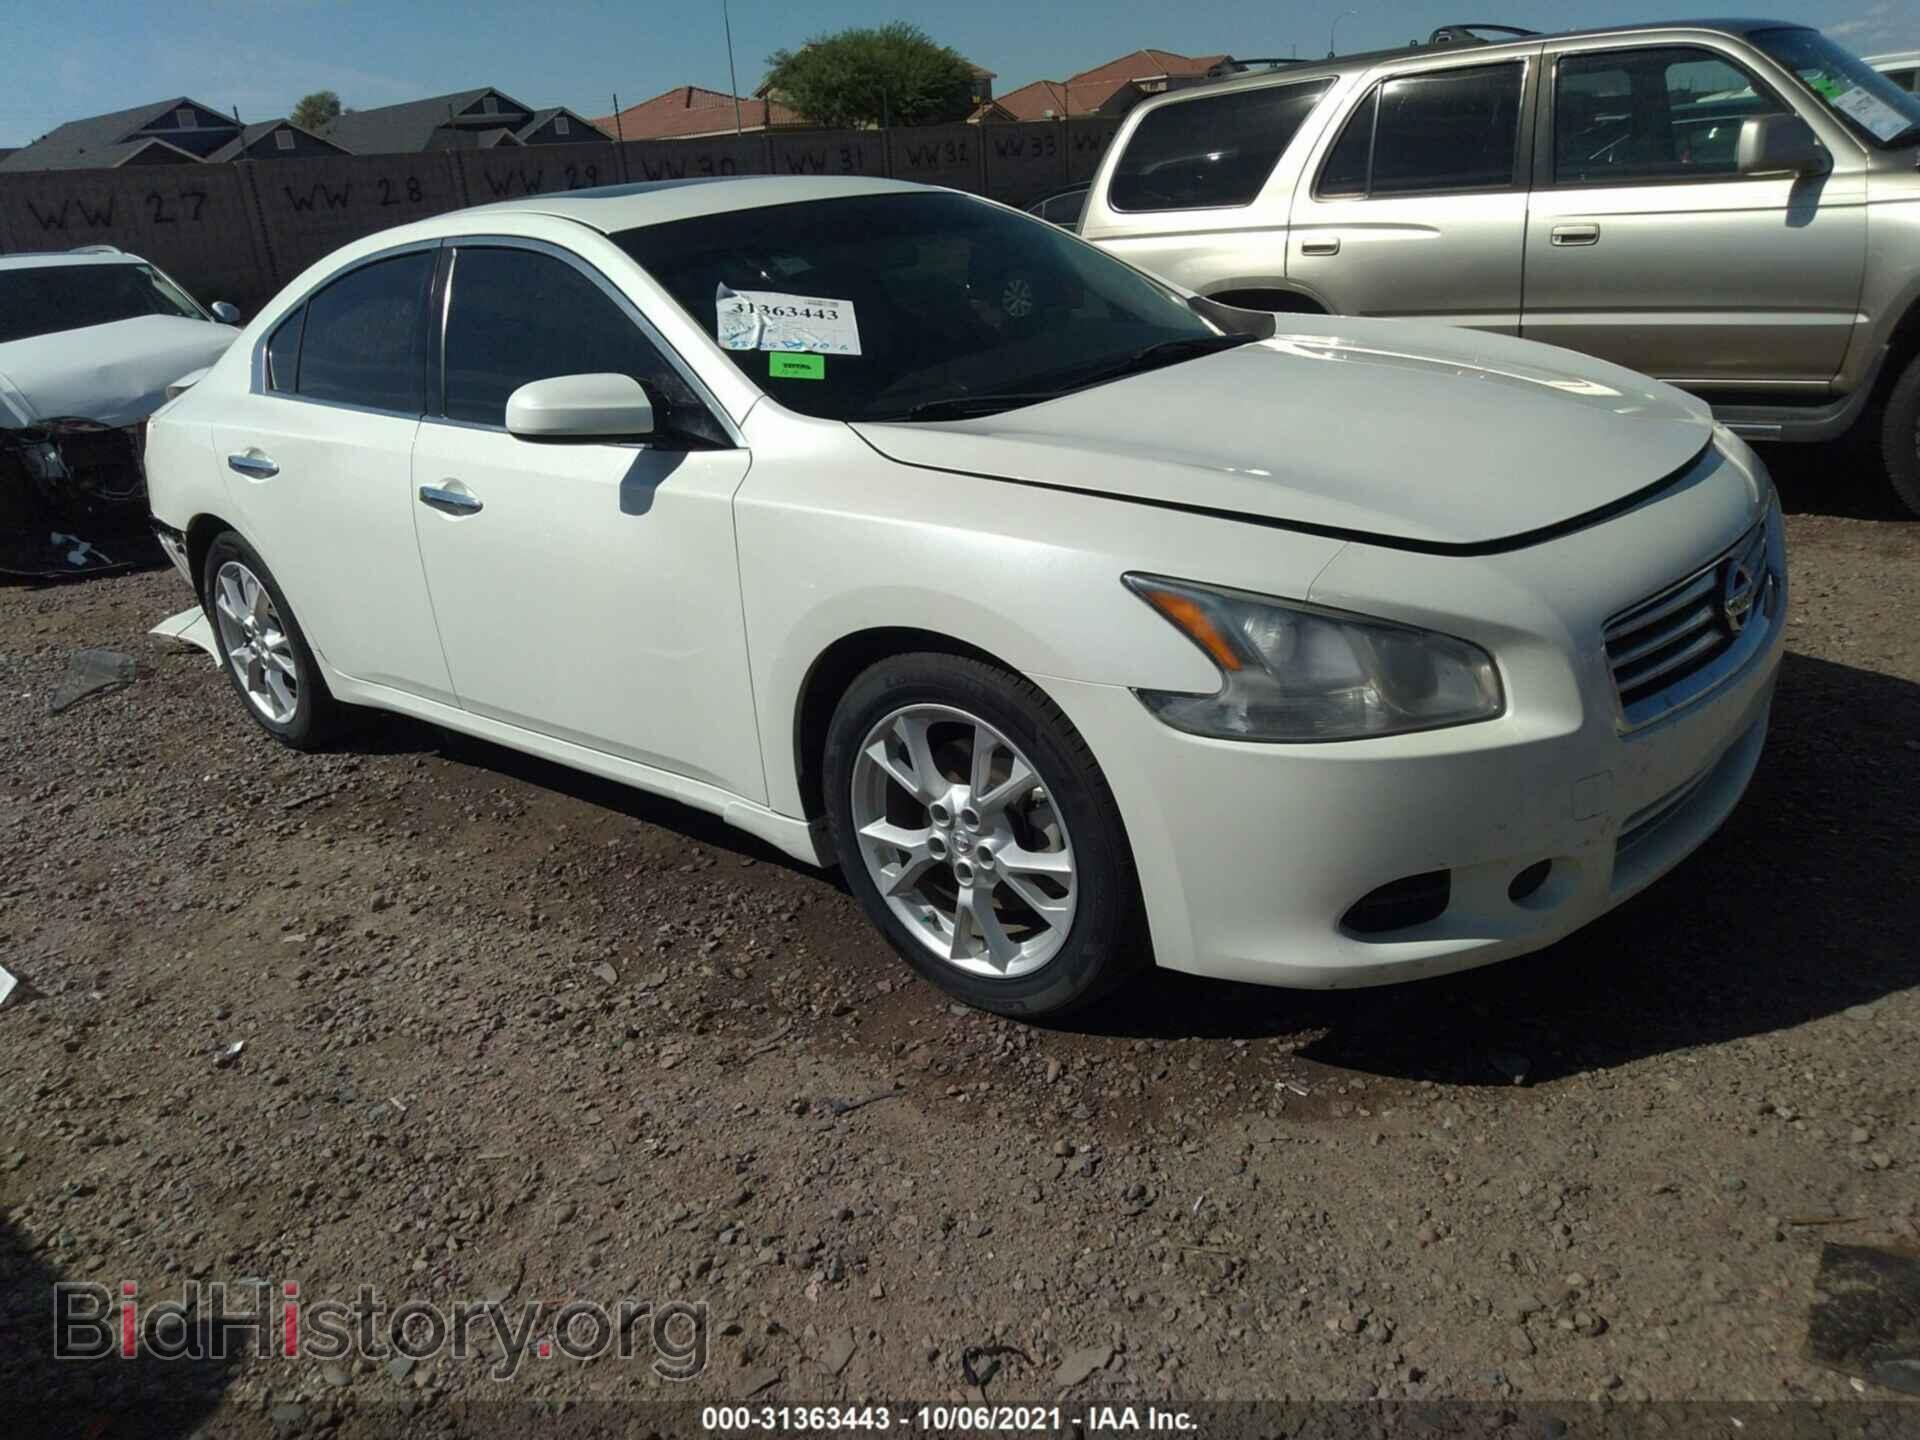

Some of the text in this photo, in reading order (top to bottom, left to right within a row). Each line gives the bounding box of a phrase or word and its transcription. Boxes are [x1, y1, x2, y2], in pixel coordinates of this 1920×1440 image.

[641, 157, 688, 180] WW
[785, 143, 864, 174] WW 31
[906, 143, 942, 169] WW
[284, 176, 423, 211] WW 28
[483, 164, 598, 197] WW 29
[25, 190, 207, 231] WW 27
[731, 302, 839, 321] 31363443
